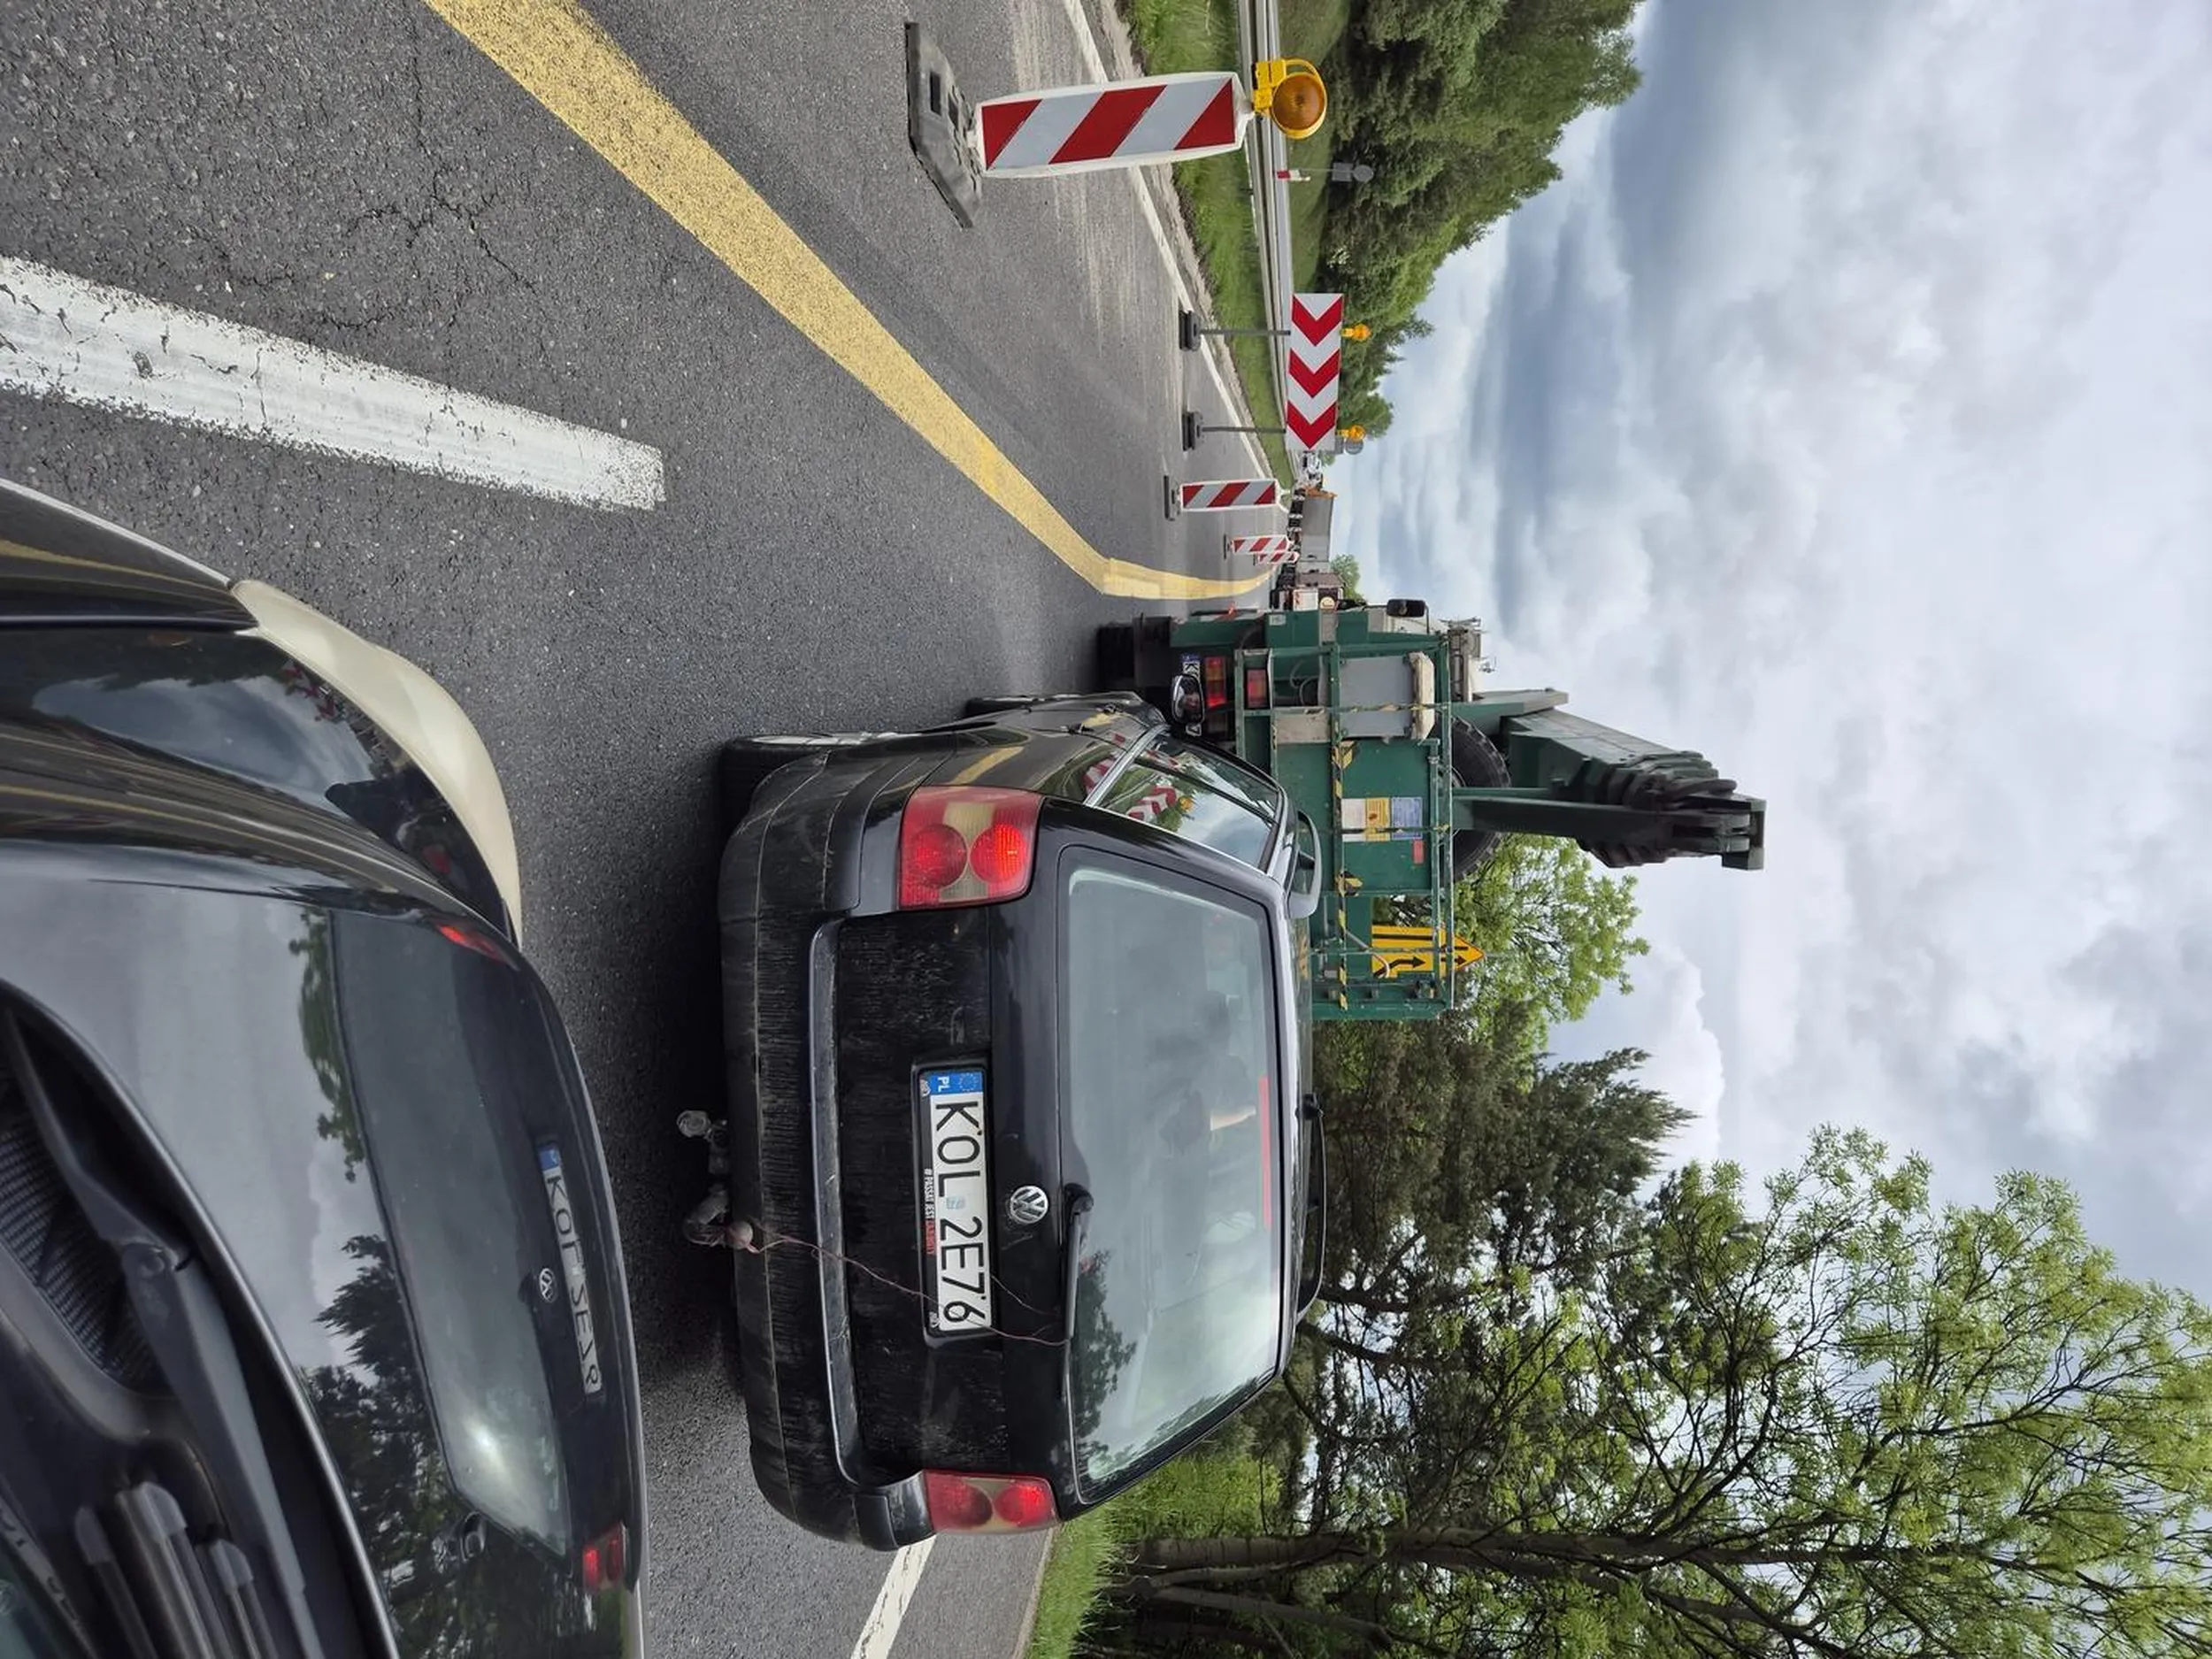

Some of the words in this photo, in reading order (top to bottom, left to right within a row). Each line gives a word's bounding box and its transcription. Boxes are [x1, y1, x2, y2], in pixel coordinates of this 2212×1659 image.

[938, 1076, 949, 1092] PL
[935, 1101, 981, 1197] KOL
[924, 1176, 934, 1202] PASSAT
[925, 1203, 935, 1218] JEST
[939, 1216, 986, 1324] 2E76
